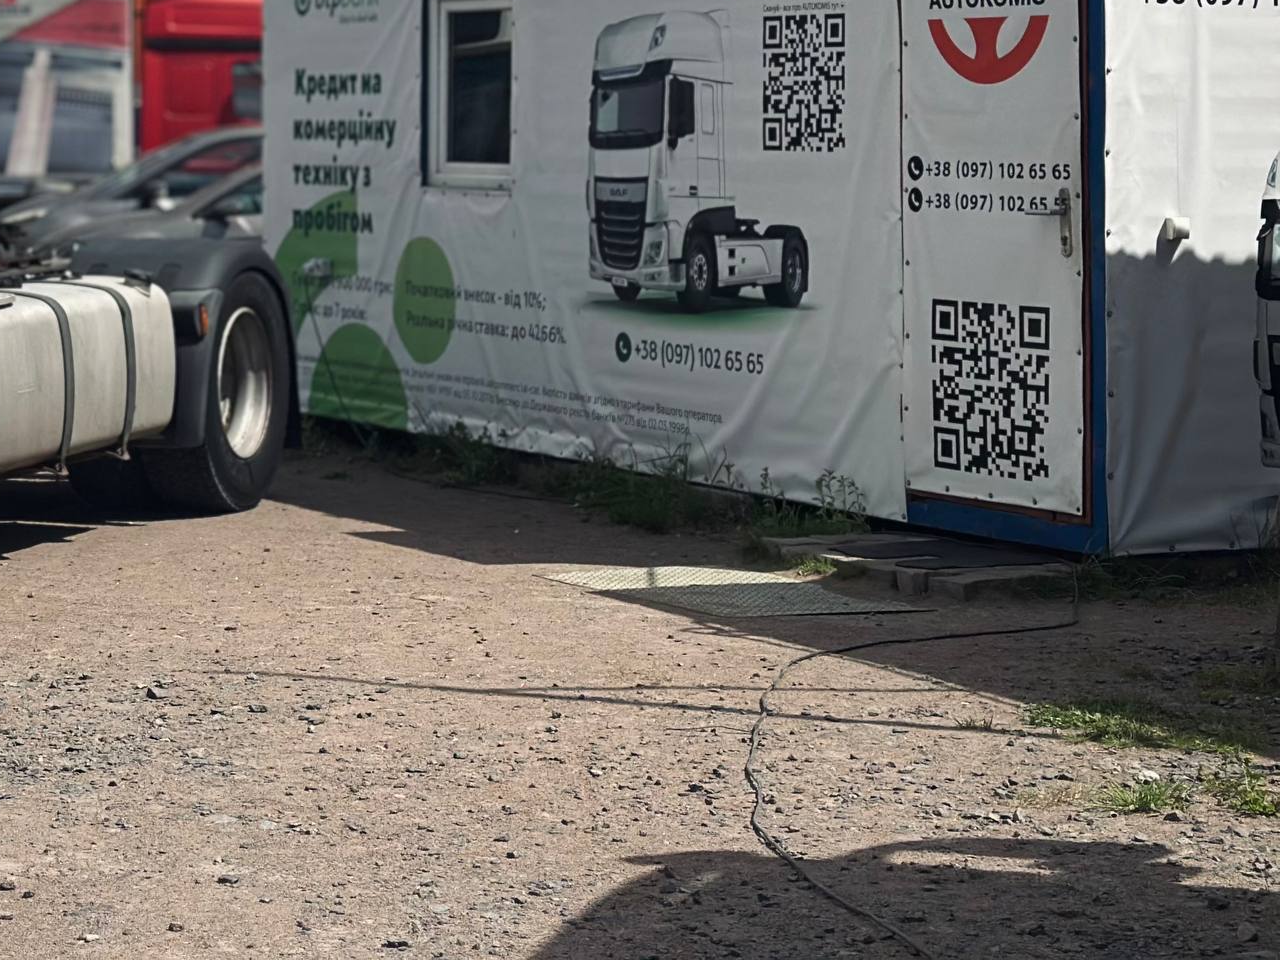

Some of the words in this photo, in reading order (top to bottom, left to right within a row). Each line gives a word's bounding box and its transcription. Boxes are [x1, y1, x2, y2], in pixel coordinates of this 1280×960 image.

[294, 68, 357, 103] Кредит
[362, 72, 382, 94] на
[293, 109, 396, 149] комерційну
[293, 155, 358, 193] техніку
[925, 161, 951, 178] +38
[956, 160, 993, 180] (097)
[999, 162, 1024, 179] 102
[1029, 163, 1047, 180] 65
[1052, 163, 1071, 180] 65
[292, 201, 373, 237] пробігом
[925, 193, 951, 209] +38
[955, 192, 993, 212] (097)
[999, 195, 1025, 212] 102
[1029, 196, 1048, 210] 65
[511, 325, 527, 341] до
[635, 339, 658, 361] +38
[661, 340, 695, 372] (097)
[698, 346, 721, 369] 102
[725, 350, 743, 372] 65
[746, 352, 764, 375] 65
